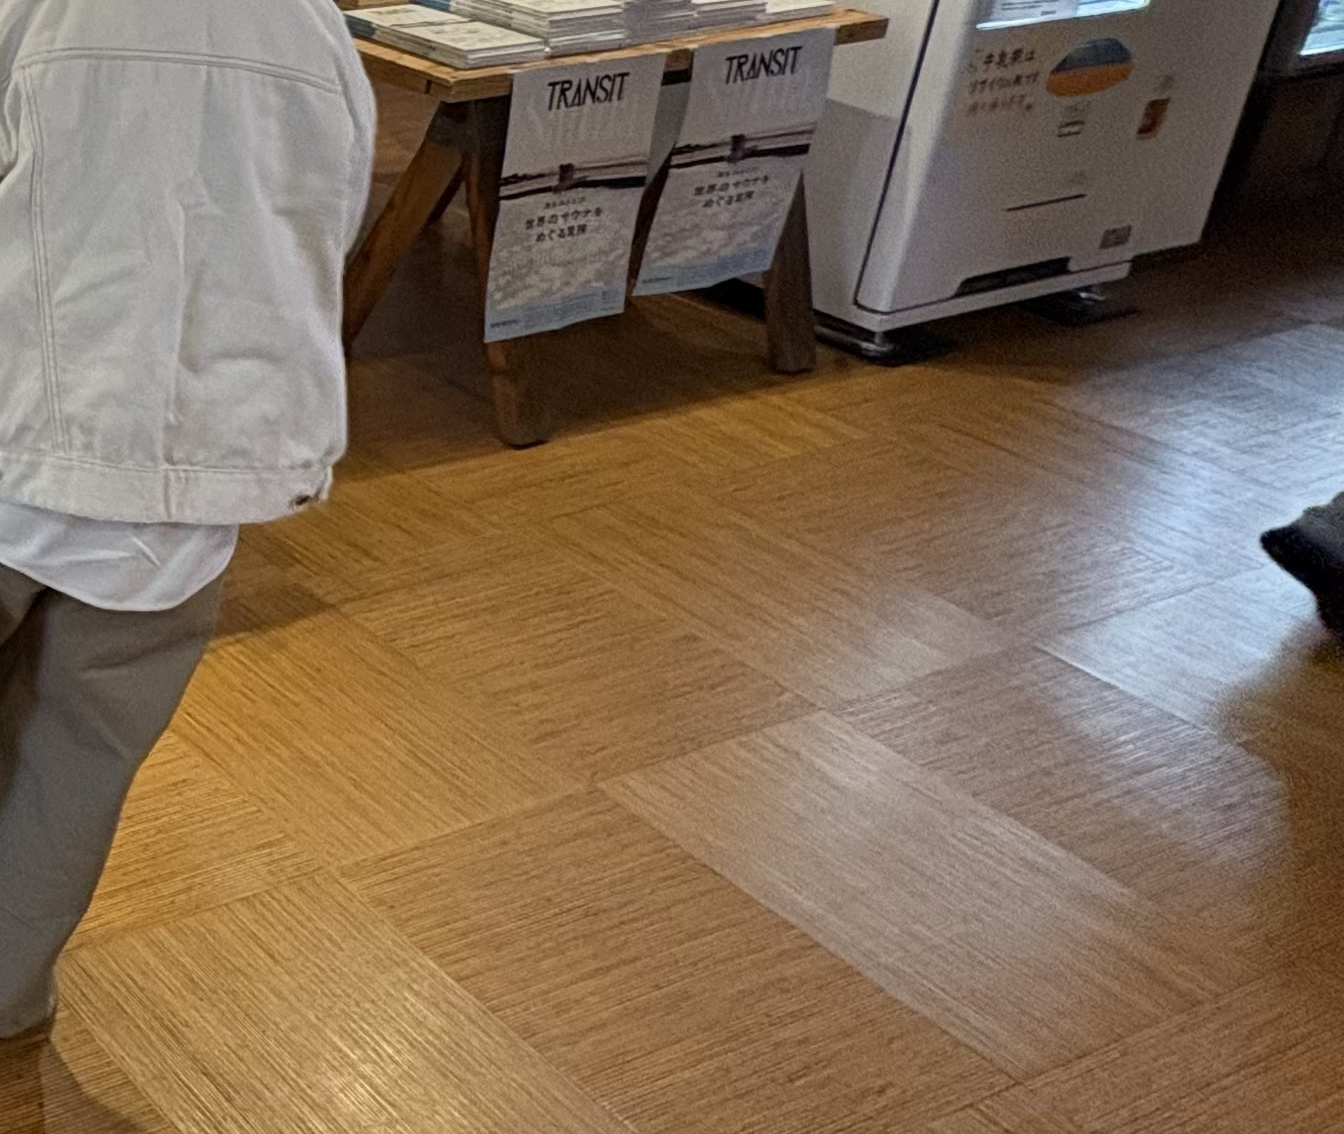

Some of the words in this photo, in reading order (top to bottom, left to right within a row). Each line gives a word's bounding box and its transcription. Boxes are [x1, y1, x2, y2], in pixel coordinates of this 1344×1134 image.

[725, 46, 803, 85] TRANSIT
[547, 72, 630, 111] TRANSIT
[525, 207, 603, 231] 世界のサウナを
